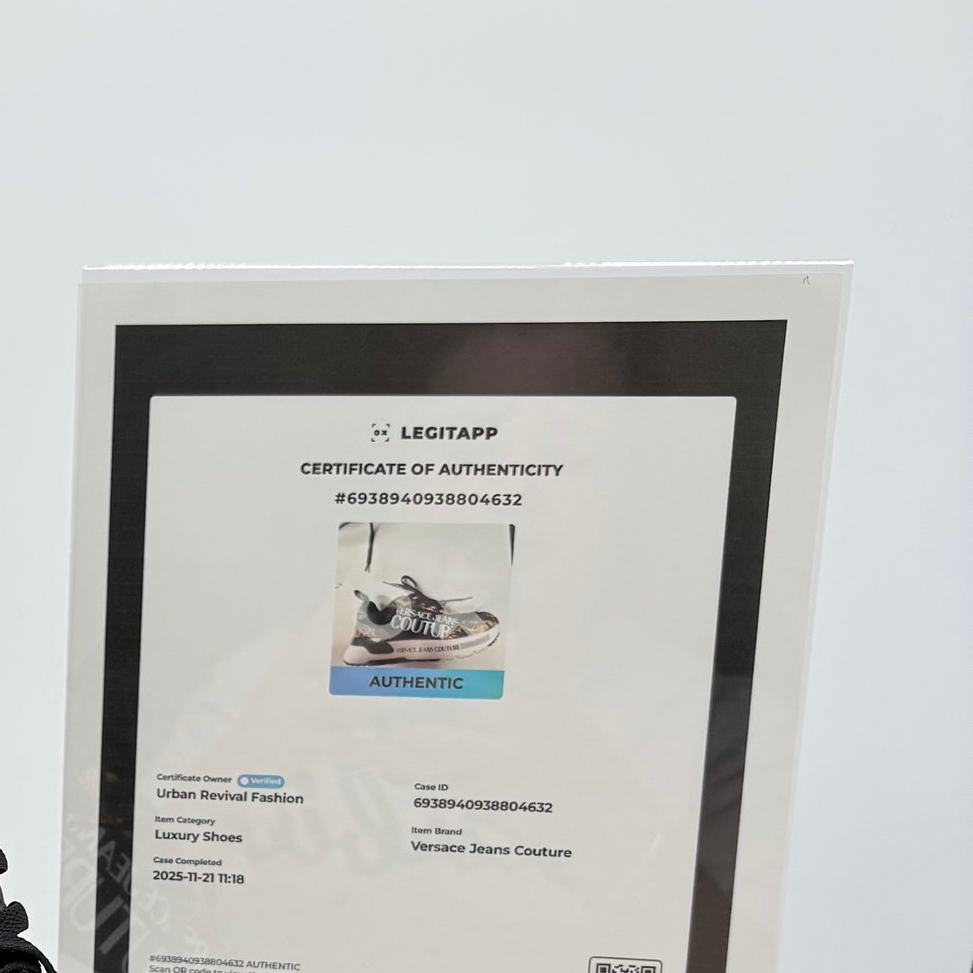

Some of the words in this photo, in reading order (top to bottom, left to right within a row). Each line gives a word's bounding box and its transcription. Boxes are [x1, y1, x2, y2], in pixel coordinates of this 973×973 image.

[401, 426, 498, 440] LEGITAPP
[301, 463, 406, 475] CERTIFICATE
[411, 463, 435, 475] OF
[438, 464, 563, 476] AUTHENTICITY
[335, 492, 522, 506] #6938940938804632
[369, 676, 463, 689] AUTHENTIC
[157, 773, 201, 782] Certificate
[203, 775, 232, 783] Owner
[251, 776, 281, 786] Verified
[414, 783, 436, 791] Case
[157, 788, 196, 799] Urban
[200, 790, 247, 802] Revival
[251, 792, 303, 804] Fashion
[414, 798, 552, 813] 6938940938804632
[176, 816, 216, 826] Category
[155, 829, 200, 843] Luxury
[203, 831, 242, 842] Shoes
[411, 841, 466, 853] Versace
[469, 843, 510, 855] Jeans
[514, 845, 572, 858] Couture
[175, 857, 222, 866] Completed
[153, 870, 214, 883] 2025-11-21
[218, 873, 244, 884] 11:18
[149, 955, 244, 967] #6938940938804632
[246, 961, 300, 971] AUTHENTIC
[149, 965, 171, 973] Scan
